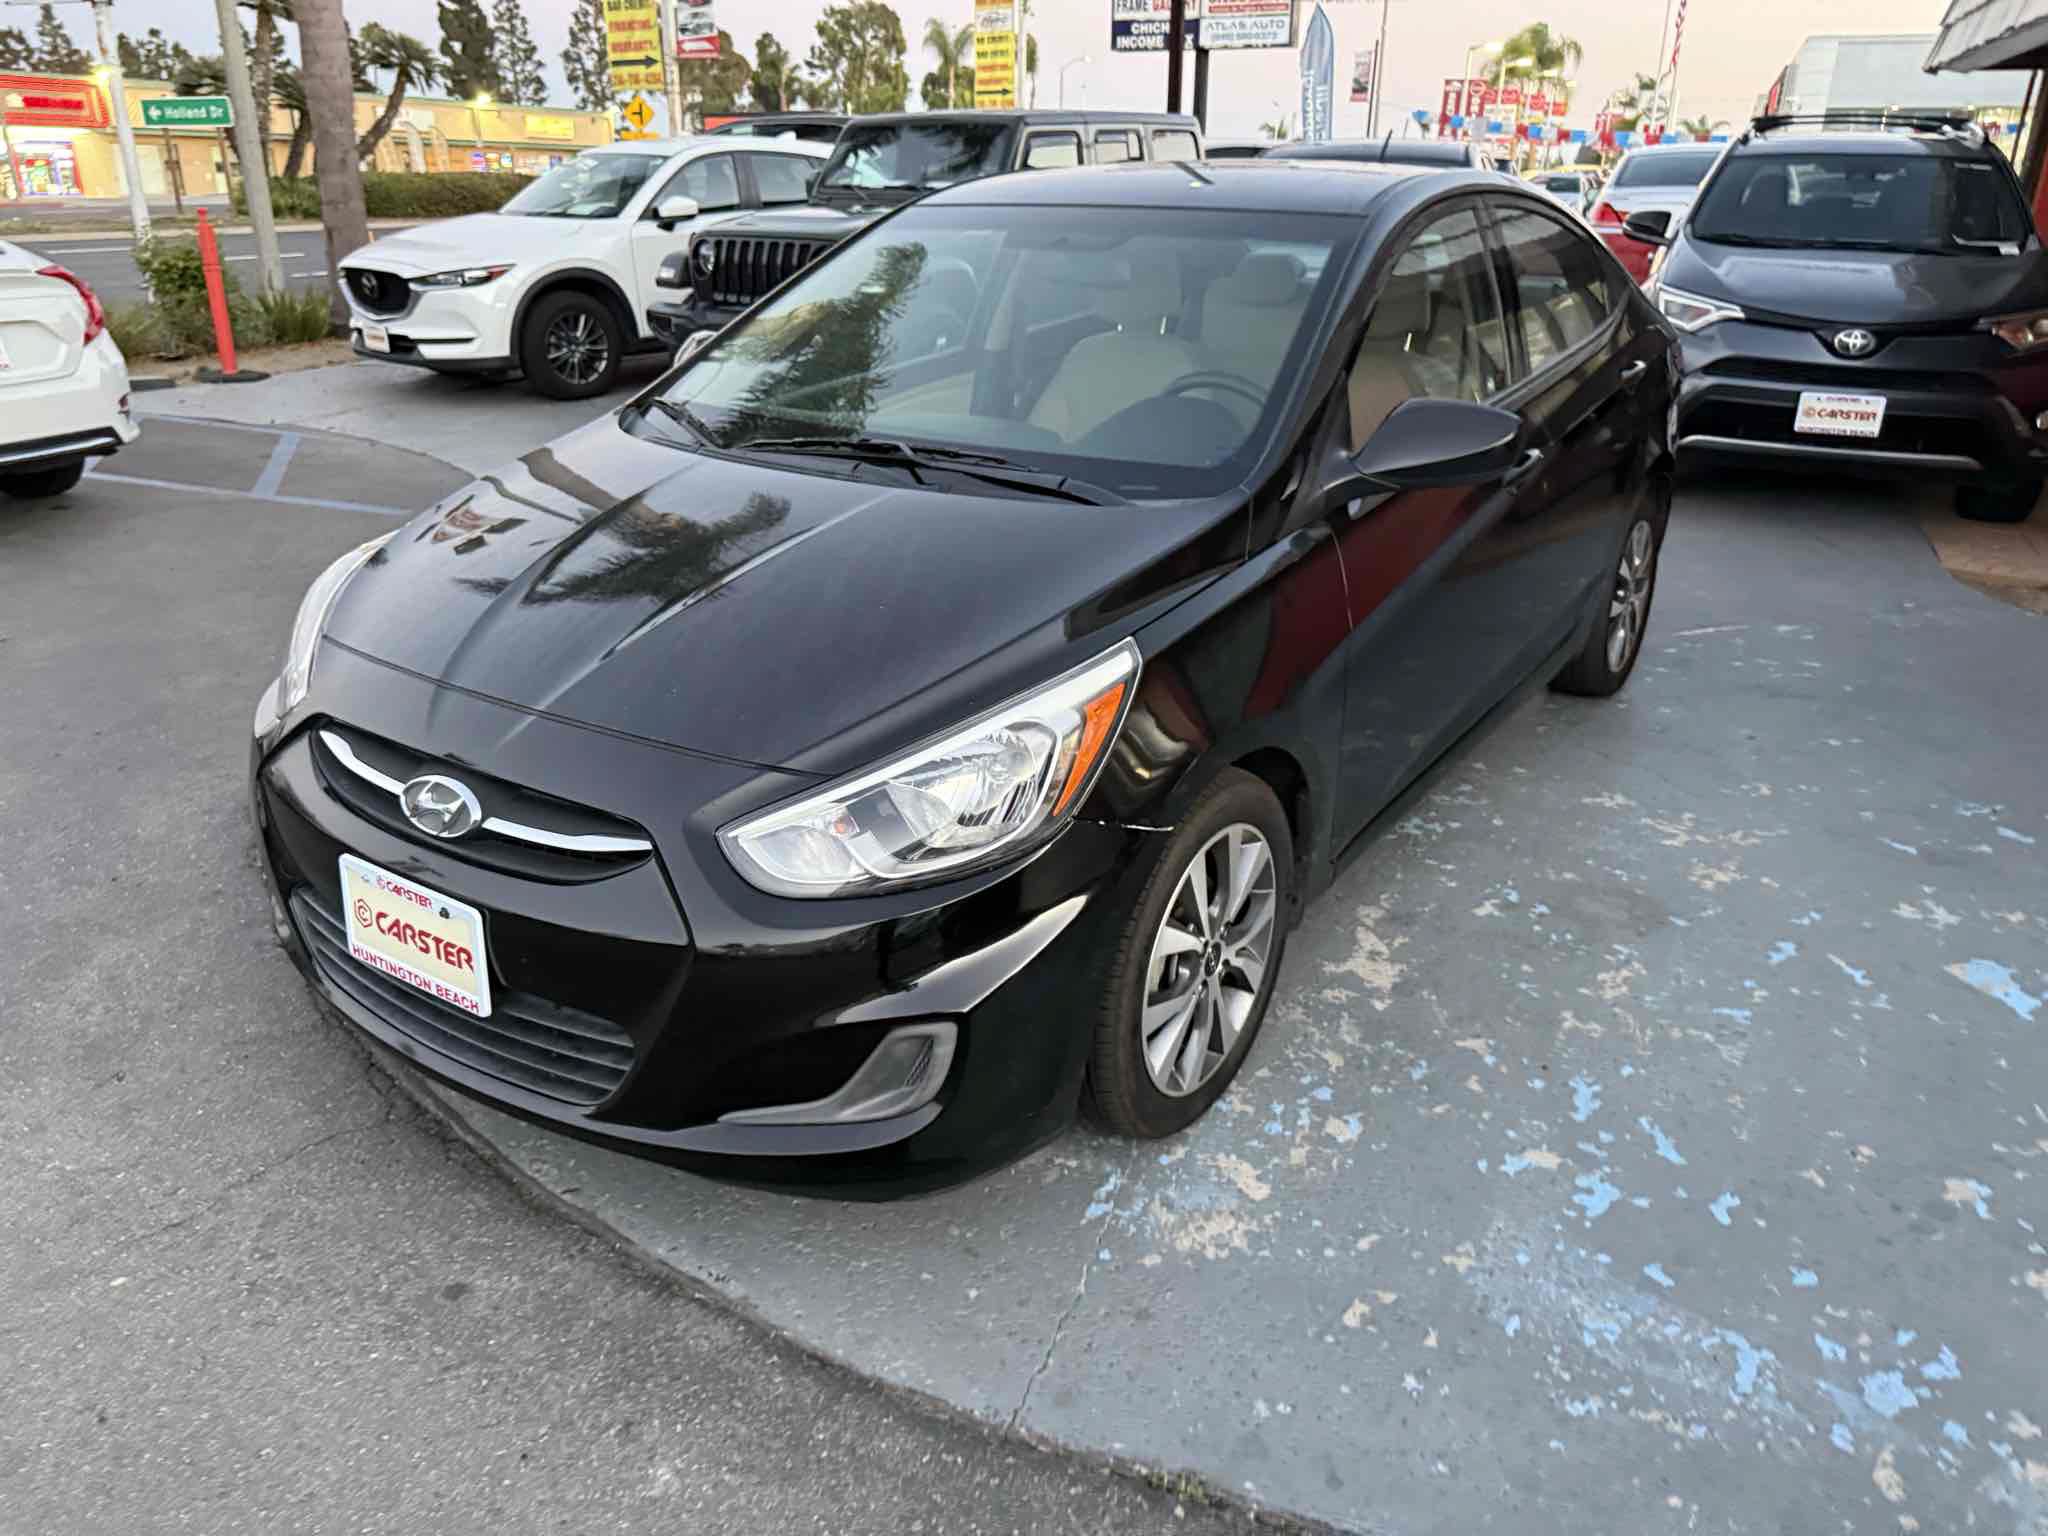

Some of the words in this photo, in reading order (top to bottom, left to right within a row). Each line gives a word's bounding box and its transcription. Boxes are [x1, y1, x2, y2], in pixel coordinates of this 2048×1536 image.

[1116, 0, 1148, 12] FRAME
[1207, 21, 1247, 31] ATLAS
[1250, 19, 1286, 30] AUTO
[1116, 34, 1165, 49] INCOME
[163, 105, 208, 119] Holland
[209, 104, 225, 119] Dr
[1817, 407, 1878, 421] CARSTER
[386, 881, 433, 909] CARSTER
[375, 911, 475, 972] CARSTER
[352, 943, 433, 992] HUNTINGTON
[435, 983, 480, 1014] BEACH
